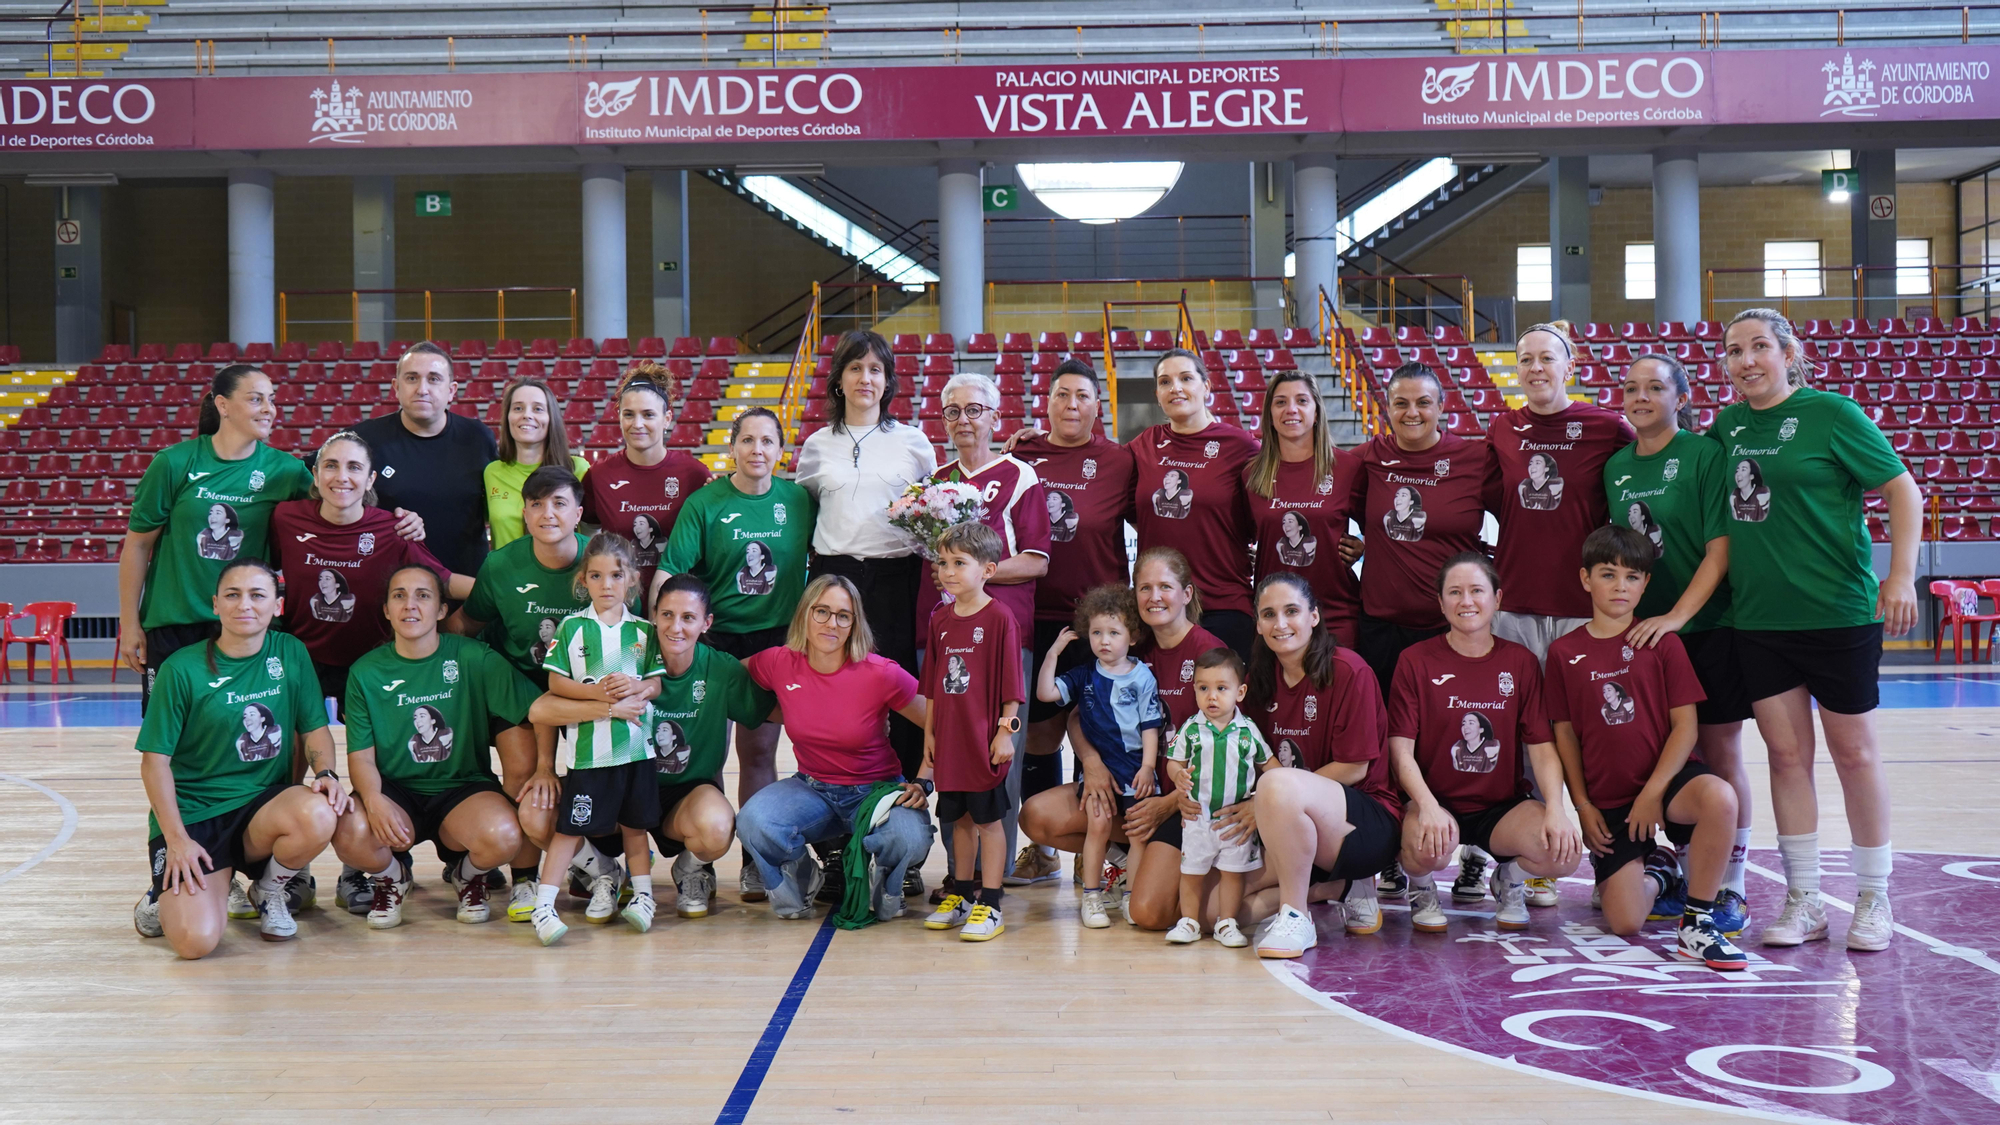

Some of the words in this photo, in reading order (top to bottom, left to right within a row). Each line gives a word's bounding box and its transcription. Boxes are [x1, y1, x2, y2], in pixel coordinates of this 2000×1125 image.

[996, 72, 1076, 87] PALACIO
[1081, 69, 1183, 86] MUNICIPAL
[1188, 66, 1280, 84] DEPORTES
[1487, 57, 1704, 102] IMDECO
[1881, 61, 1990, 82] AYUNTAMIENTO
[367, 89, 473, 109] AYUNTAMIENTO
[648, 73, 863, 116] IMDECO
[1881, 85, 1899, 105] DE
[1903, 82, 1974, 105] CÓRDOBA
[975, 93, 1107, 133] VISTA
[1122, 88, 1309, 130] ALEGRE
[1423, 111, 1480, 126] Instituto
[1483, 110, 1551, 127] Municipal
[1554, 109, 1573, 123] de
[1576, 108, 1640, 125] Deportes
[1643, 107, 1703, 121] Córdoba
[367, 113, 386, 132] DE
[389, 110, 458, 132] CÓRDOBA
[586, 126, 642, 139] Instituto
[645, 123, 712, 140] Municipal
[715, 124, 733, 137] de
[736, 123, 799, 139] Deportes
[802, 122, 861, 136] Córdoba
[9, 135, 27, 147] de
[30, 134, 93, 149] Deportes
[96, 133, 155, 146] Córdoba
[1833, 172, 1849, 191] D
[425, 194, 441, 213] B
[992, 188, 1009, 208] C
[1526, 441, 1575, 451] Memorial
[1737, 445, 1783, 456] Memorial
[1165, 458, 1209, 469] Memorial
[1043, 481, 1088, 491] Memorial
[1392, 474, 1440, 487] Memorial
[205, 491, 255, 503] Memorial
[984, 480, 1001, 502] 6
[1626, 486, 1668, 501] Memorial
[626, 502, 673, 513] Memorial
[1277, 500, 1324, 509] Memorial
[740, 529, 782, 540] Memorial
[312, 557, 363, 568] Memorial
[1596, 666, 1630, 680] Memorial
[234, 684, 282, 704] Memorial
[404, 688, 453, 706] Memorial
[653, 709, 699, 719] Memorial
[1456, 700, 1507, 710] Memorial
